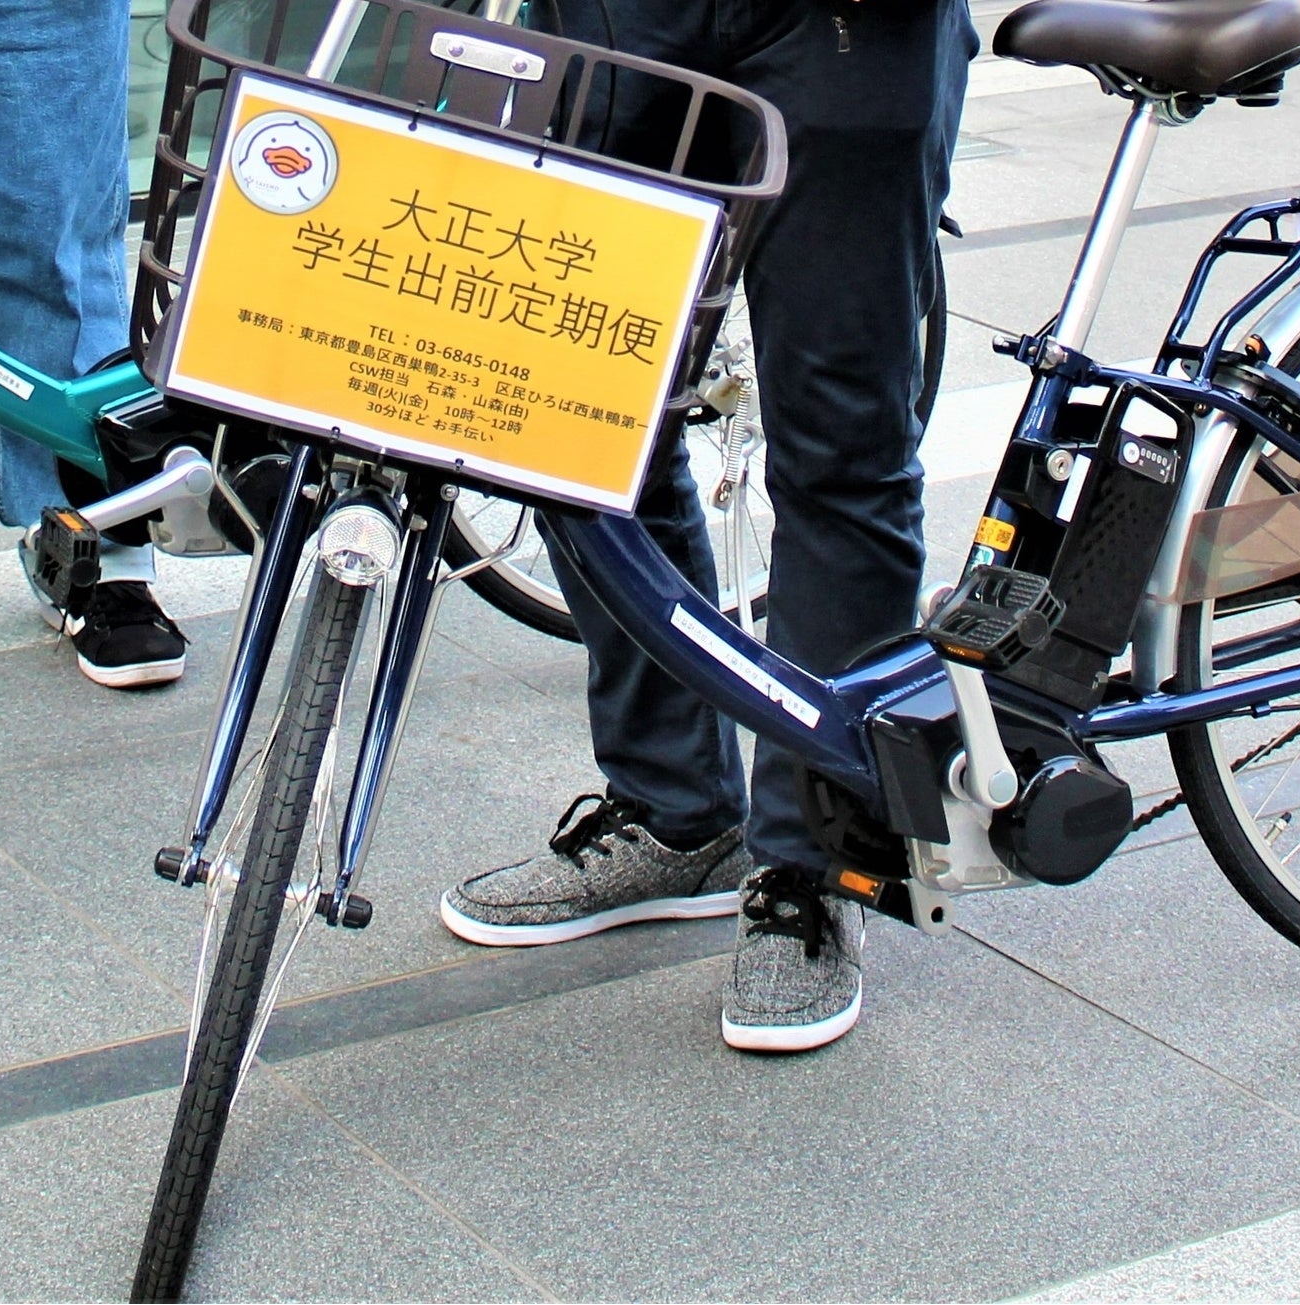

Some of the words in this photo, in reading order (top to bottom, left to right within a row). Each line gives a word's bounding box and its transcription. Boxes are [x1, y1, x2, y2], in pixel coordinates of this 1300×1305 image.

[382, 189, 596, 281] 大正大学
[292, 220, 663, 365] 学生出前定期便
[349, 361, 410, 387] CSW担当
[369, 325, 530, 381] TEL：03-6845-0148
[347, 376, 429, 411] 毎週(火)(金)
[495, 381, 649, 430] 区民ひろば西巣鴨第一
[366, 401, 430, 426] 30分ほど
[433, 419, 494, 443] お手伝い
